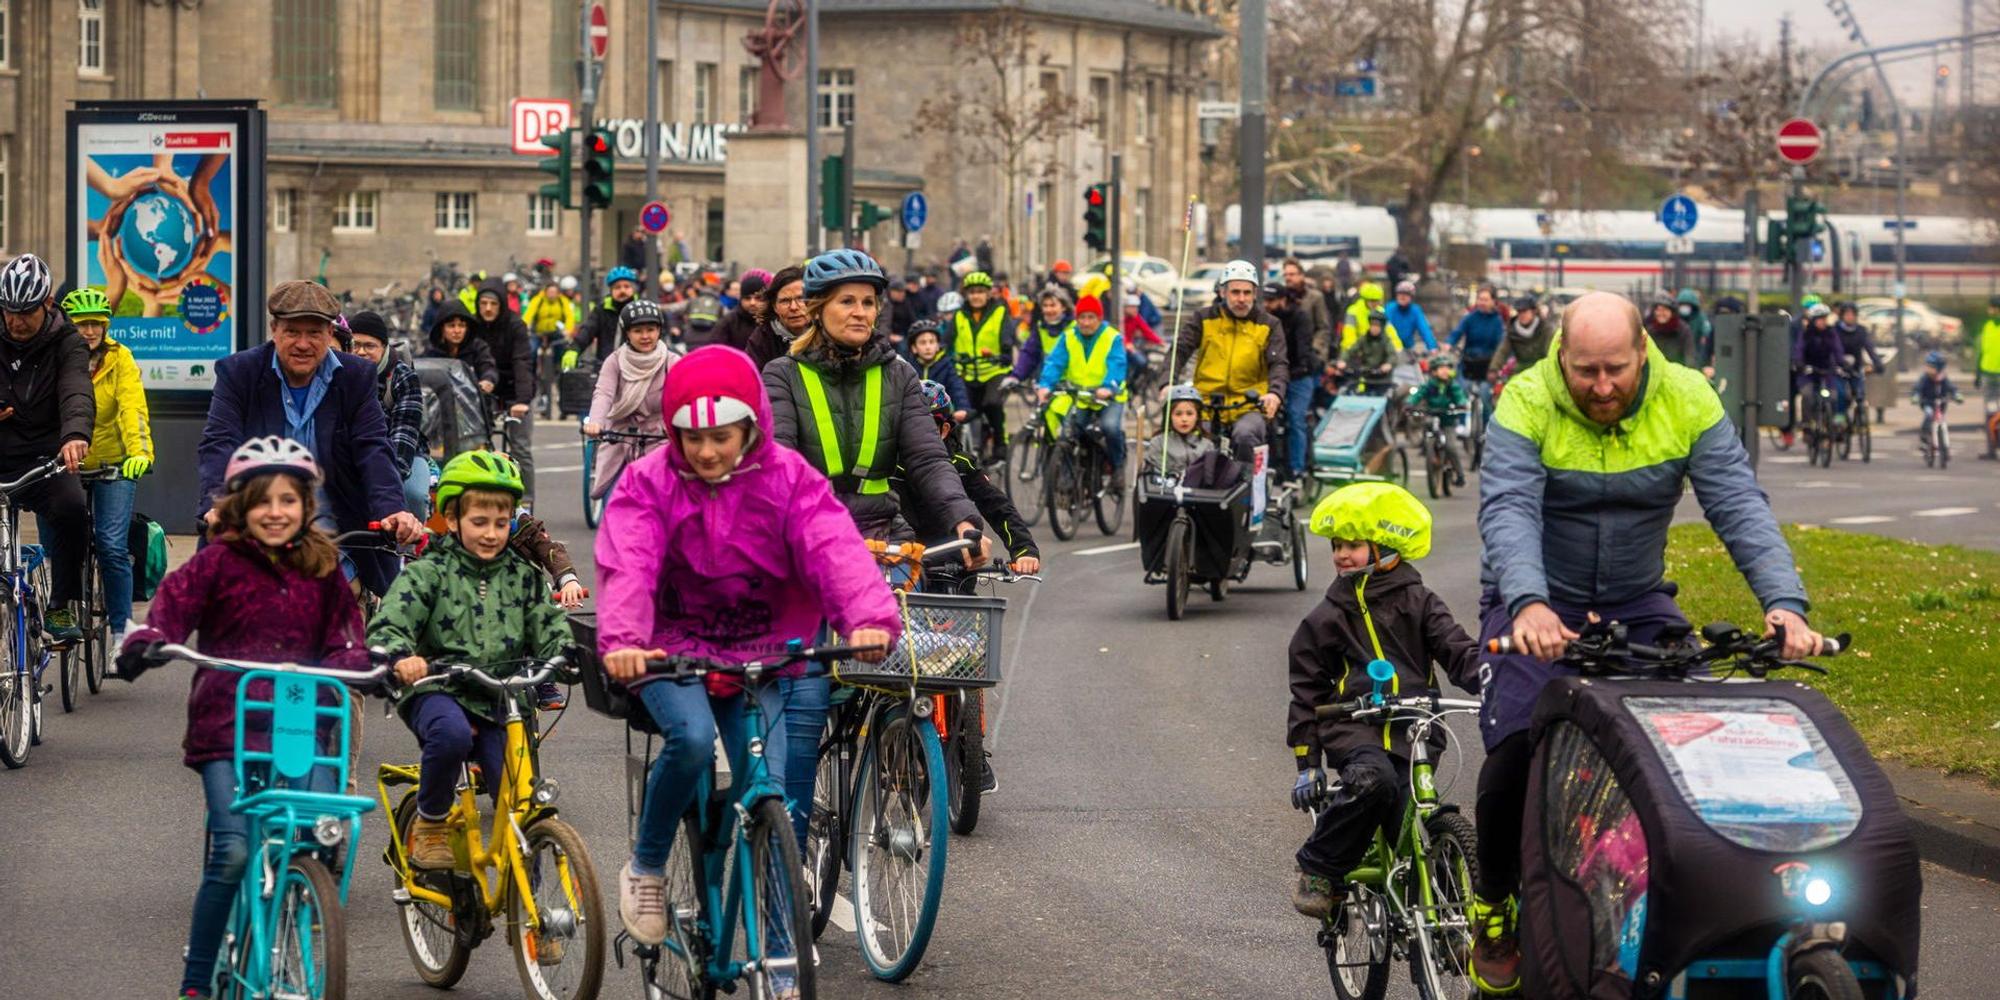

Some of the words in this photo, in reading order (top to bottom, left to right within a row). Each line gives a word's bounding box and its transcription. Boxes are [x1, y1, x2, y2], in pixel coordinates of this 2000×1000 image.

[137, 113, 177, 122] JCDecaux
[522, 109, 563, 143] DB
[165, 137, 182, 145] Stadt
[129, 326, 148, 339] Sie
[150, 326, 176, 339] mit!
